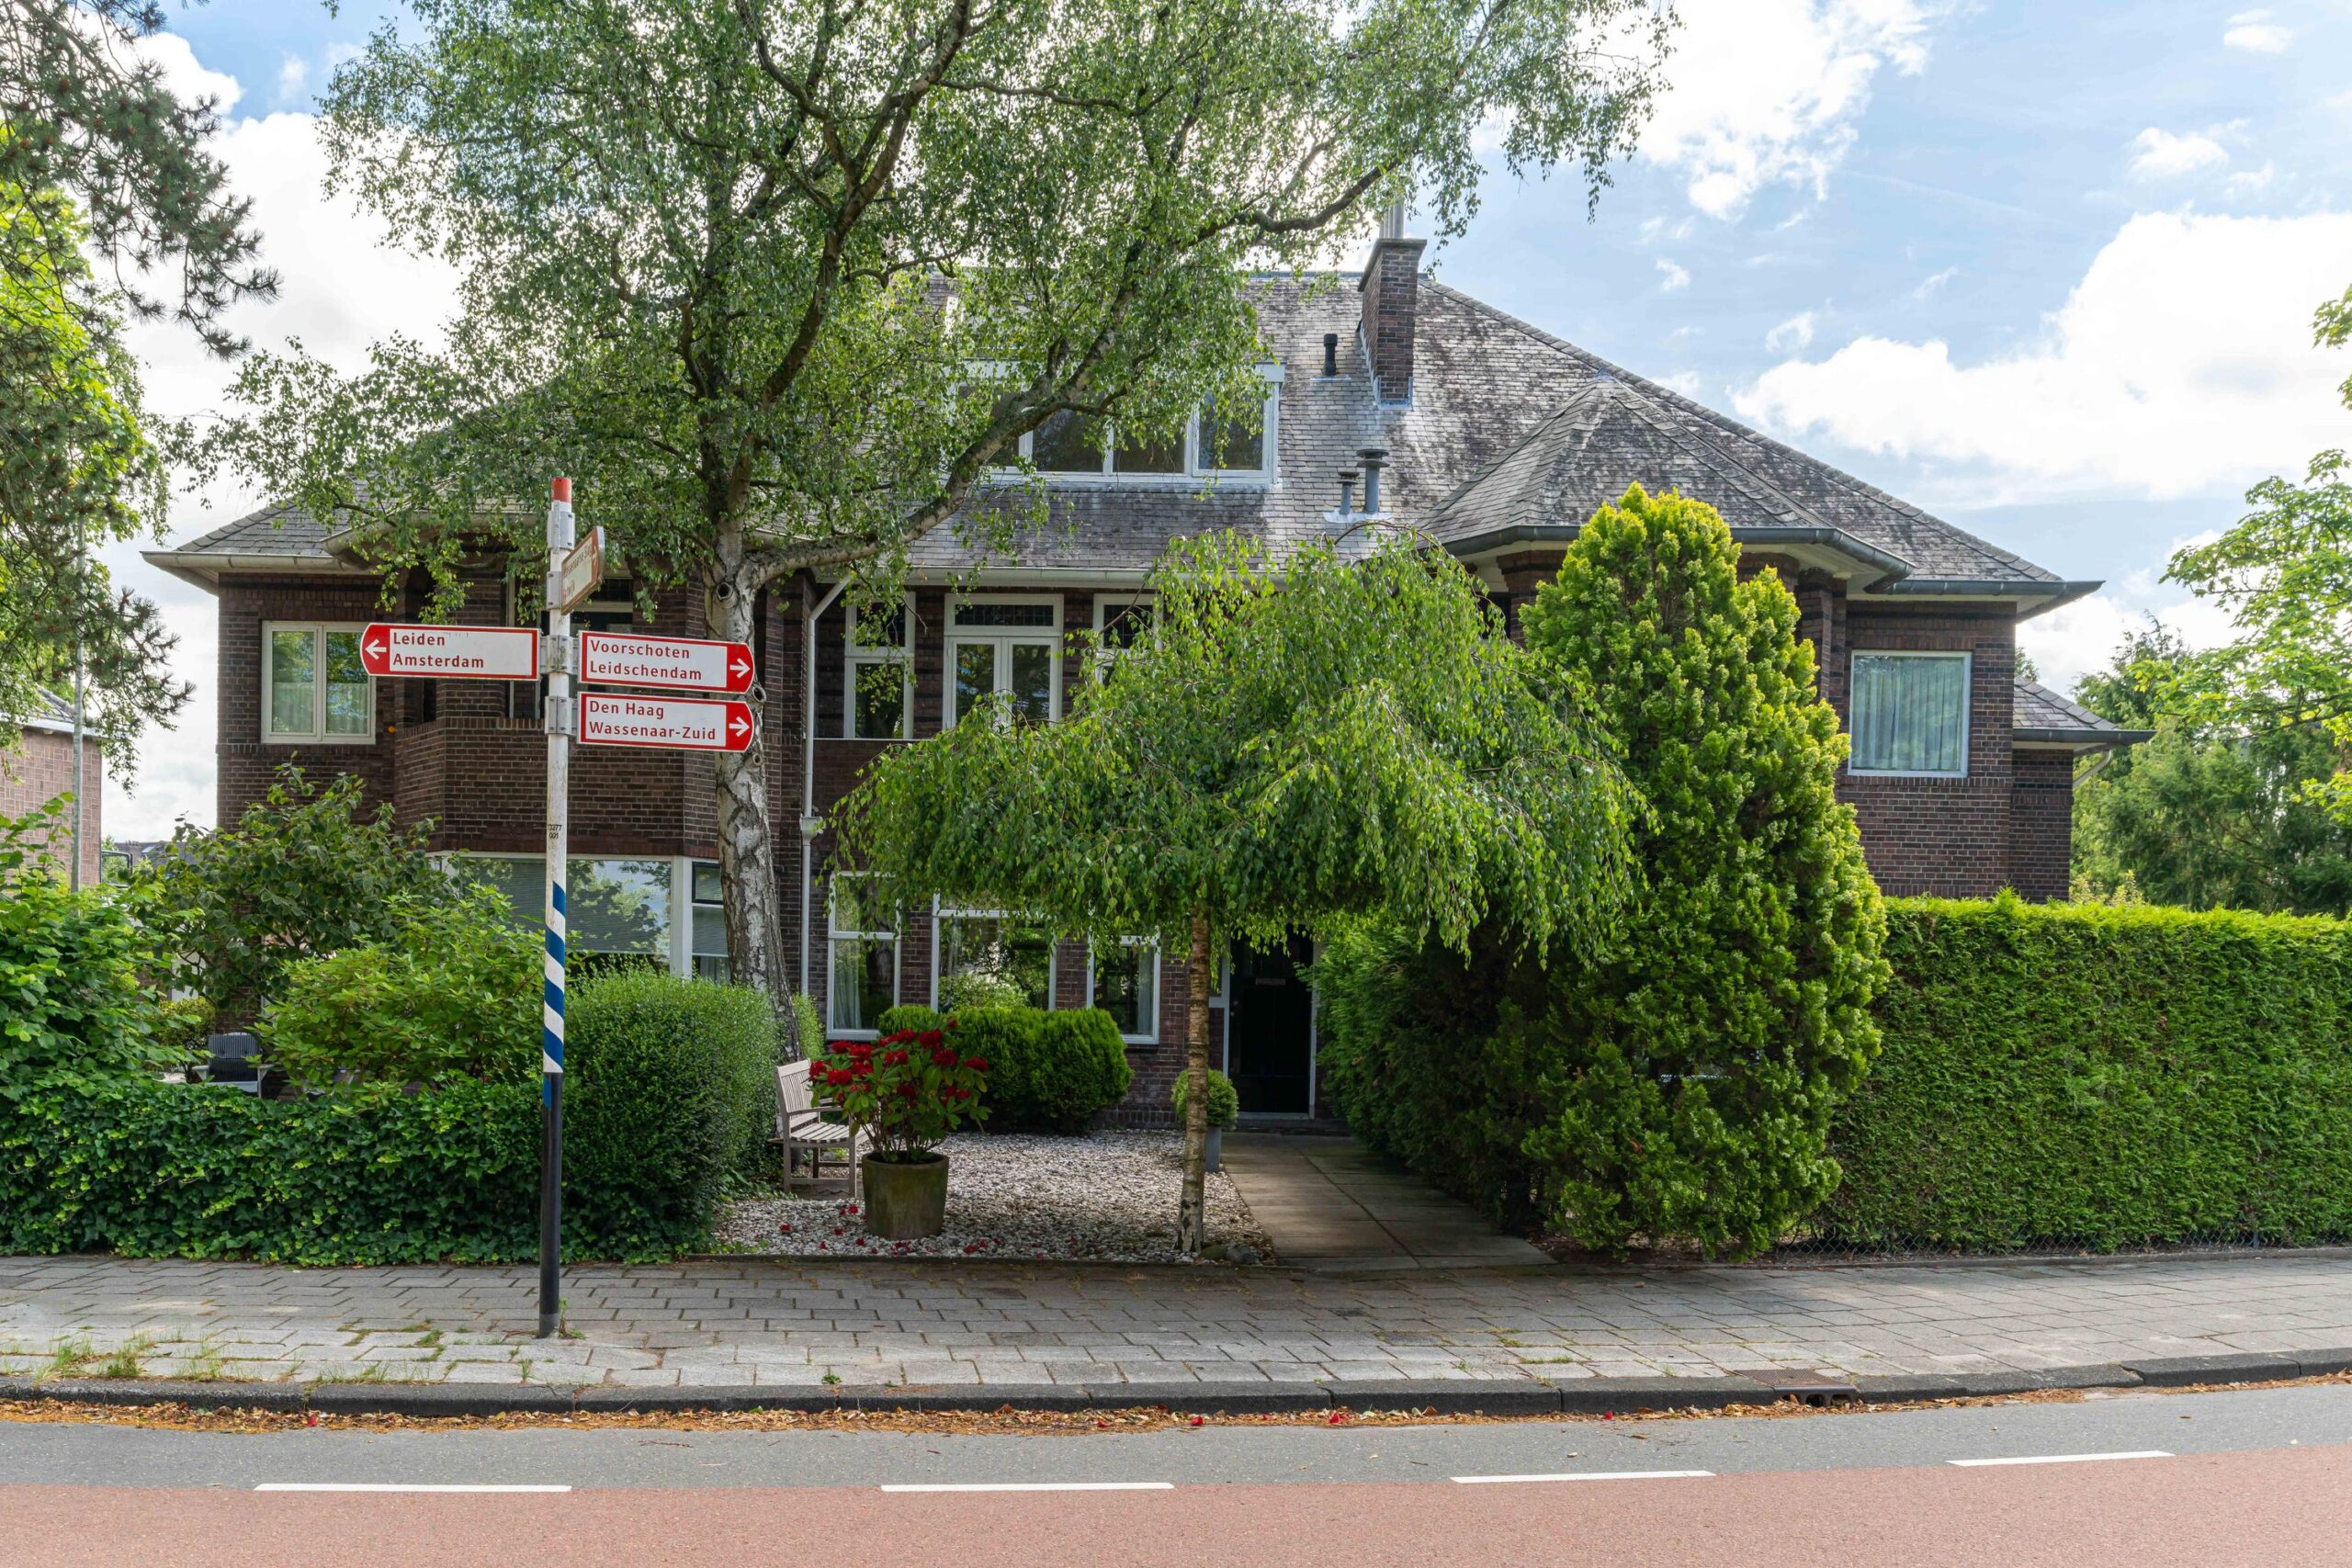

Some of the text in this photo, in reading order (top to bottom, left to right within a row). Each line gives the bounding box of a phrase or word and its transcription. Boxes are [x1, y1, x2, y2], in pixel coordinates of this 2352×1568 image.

[393, 632, 445, 646] Leiden
[590, 639, 690, 659] Voorschoten
[393, 653, 484, 668] Amsterdam
[590, 660, 702, 680] Leidschendam
[589, 700, 664, 719] Den Haag
[589, 721, 716, 740] Wassenaar-Zuid
